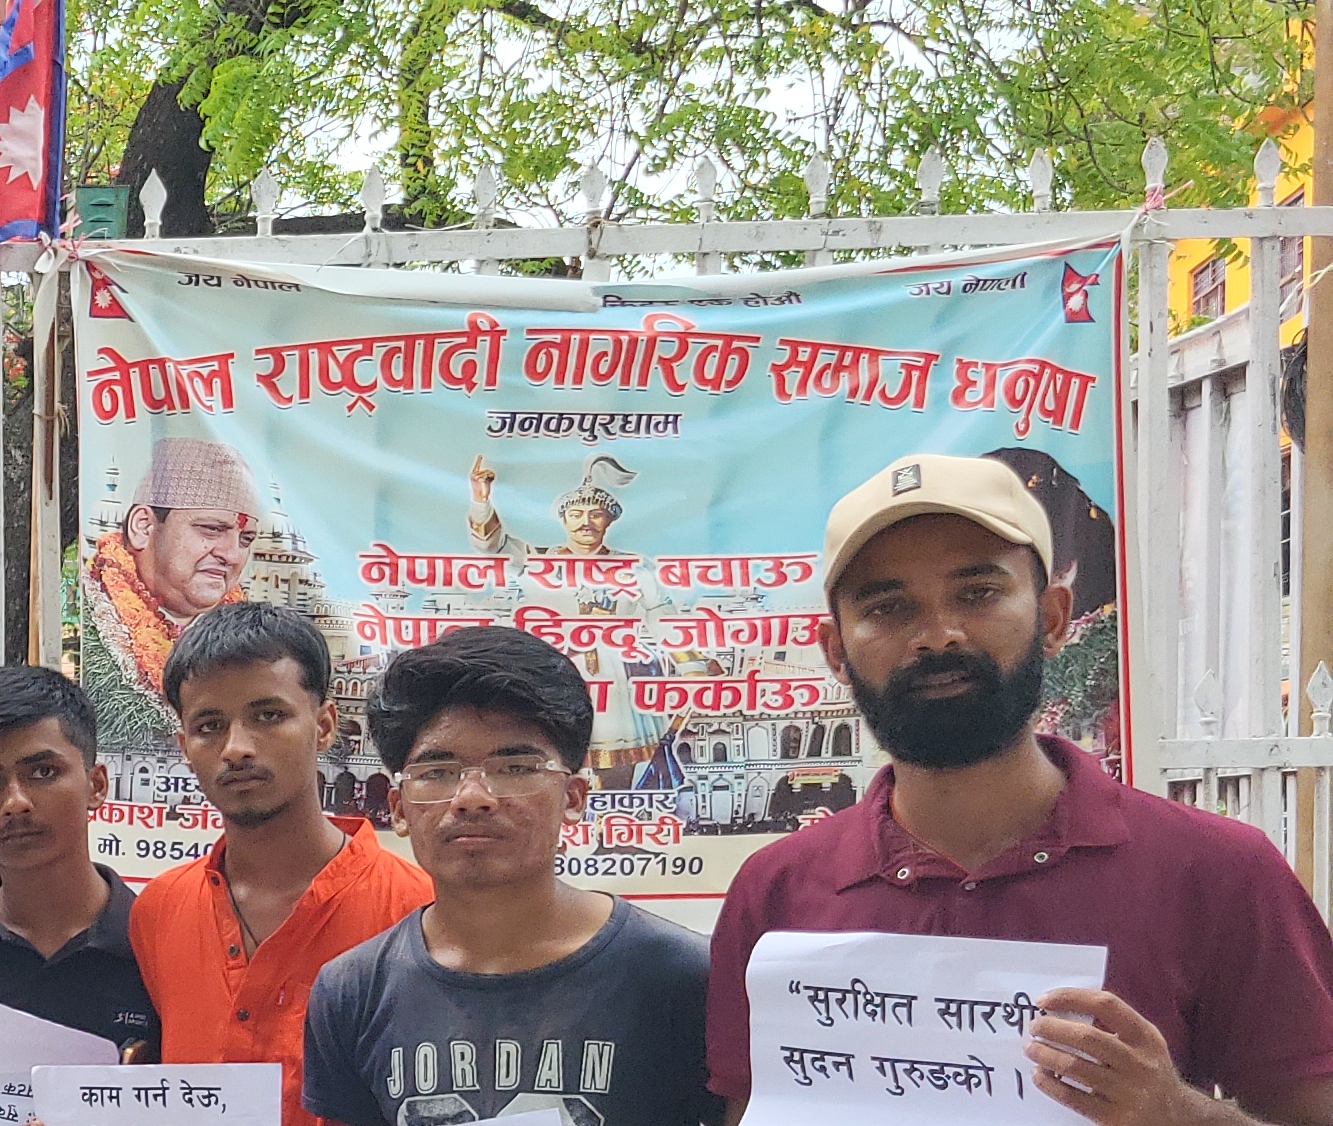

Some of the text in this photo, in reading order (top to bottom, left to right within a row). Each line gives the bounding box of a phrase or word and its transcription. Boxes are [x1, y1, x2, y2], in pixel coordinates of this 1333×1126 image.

[904, 279, 953, 297] जय
[87, 346, 235, 424] नेपाल
[254, 311, 507, 416] राष्ट्रवादी
[523, 312, 761, 395] नागरिक
[767, 336, 938, 411] समाज
[486, 409, 683, 445] जनकपुरधाम
[359, 543, 510, 590] नेपाल
[527, 555, 642, 598] राष्ट्र
[603, 814, 685, 847] गिरी
[386, 1038, 616, 1099] JORDAN
[779, 1044, 855, 1087] सुदन
[870, 1054, 995, 1097] गुरुङको
[79, 1079, 227, 1113] काम गर्न देऊ,
